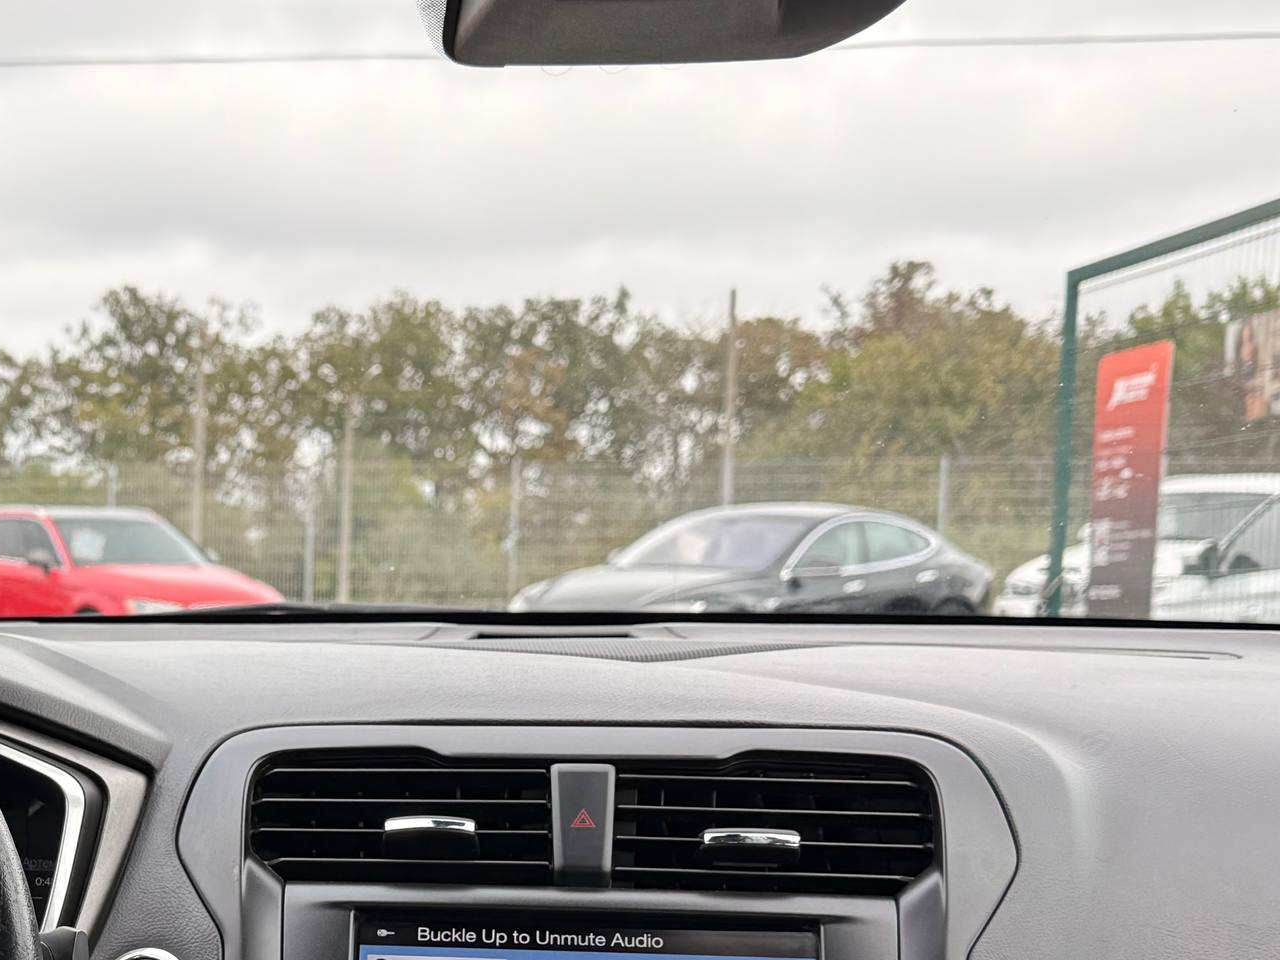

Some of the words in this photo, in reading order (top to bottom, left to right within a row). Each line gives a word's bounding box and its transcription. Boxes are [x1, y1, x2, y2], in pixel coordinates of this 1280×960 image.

[417, 926, 477, 942] Buckle
[482, 928, 508, 946] Up
[512, 930, 530, 944] to
[536, 930, 606, 946] Unmute
[611, 932, 664, 948] Audio
